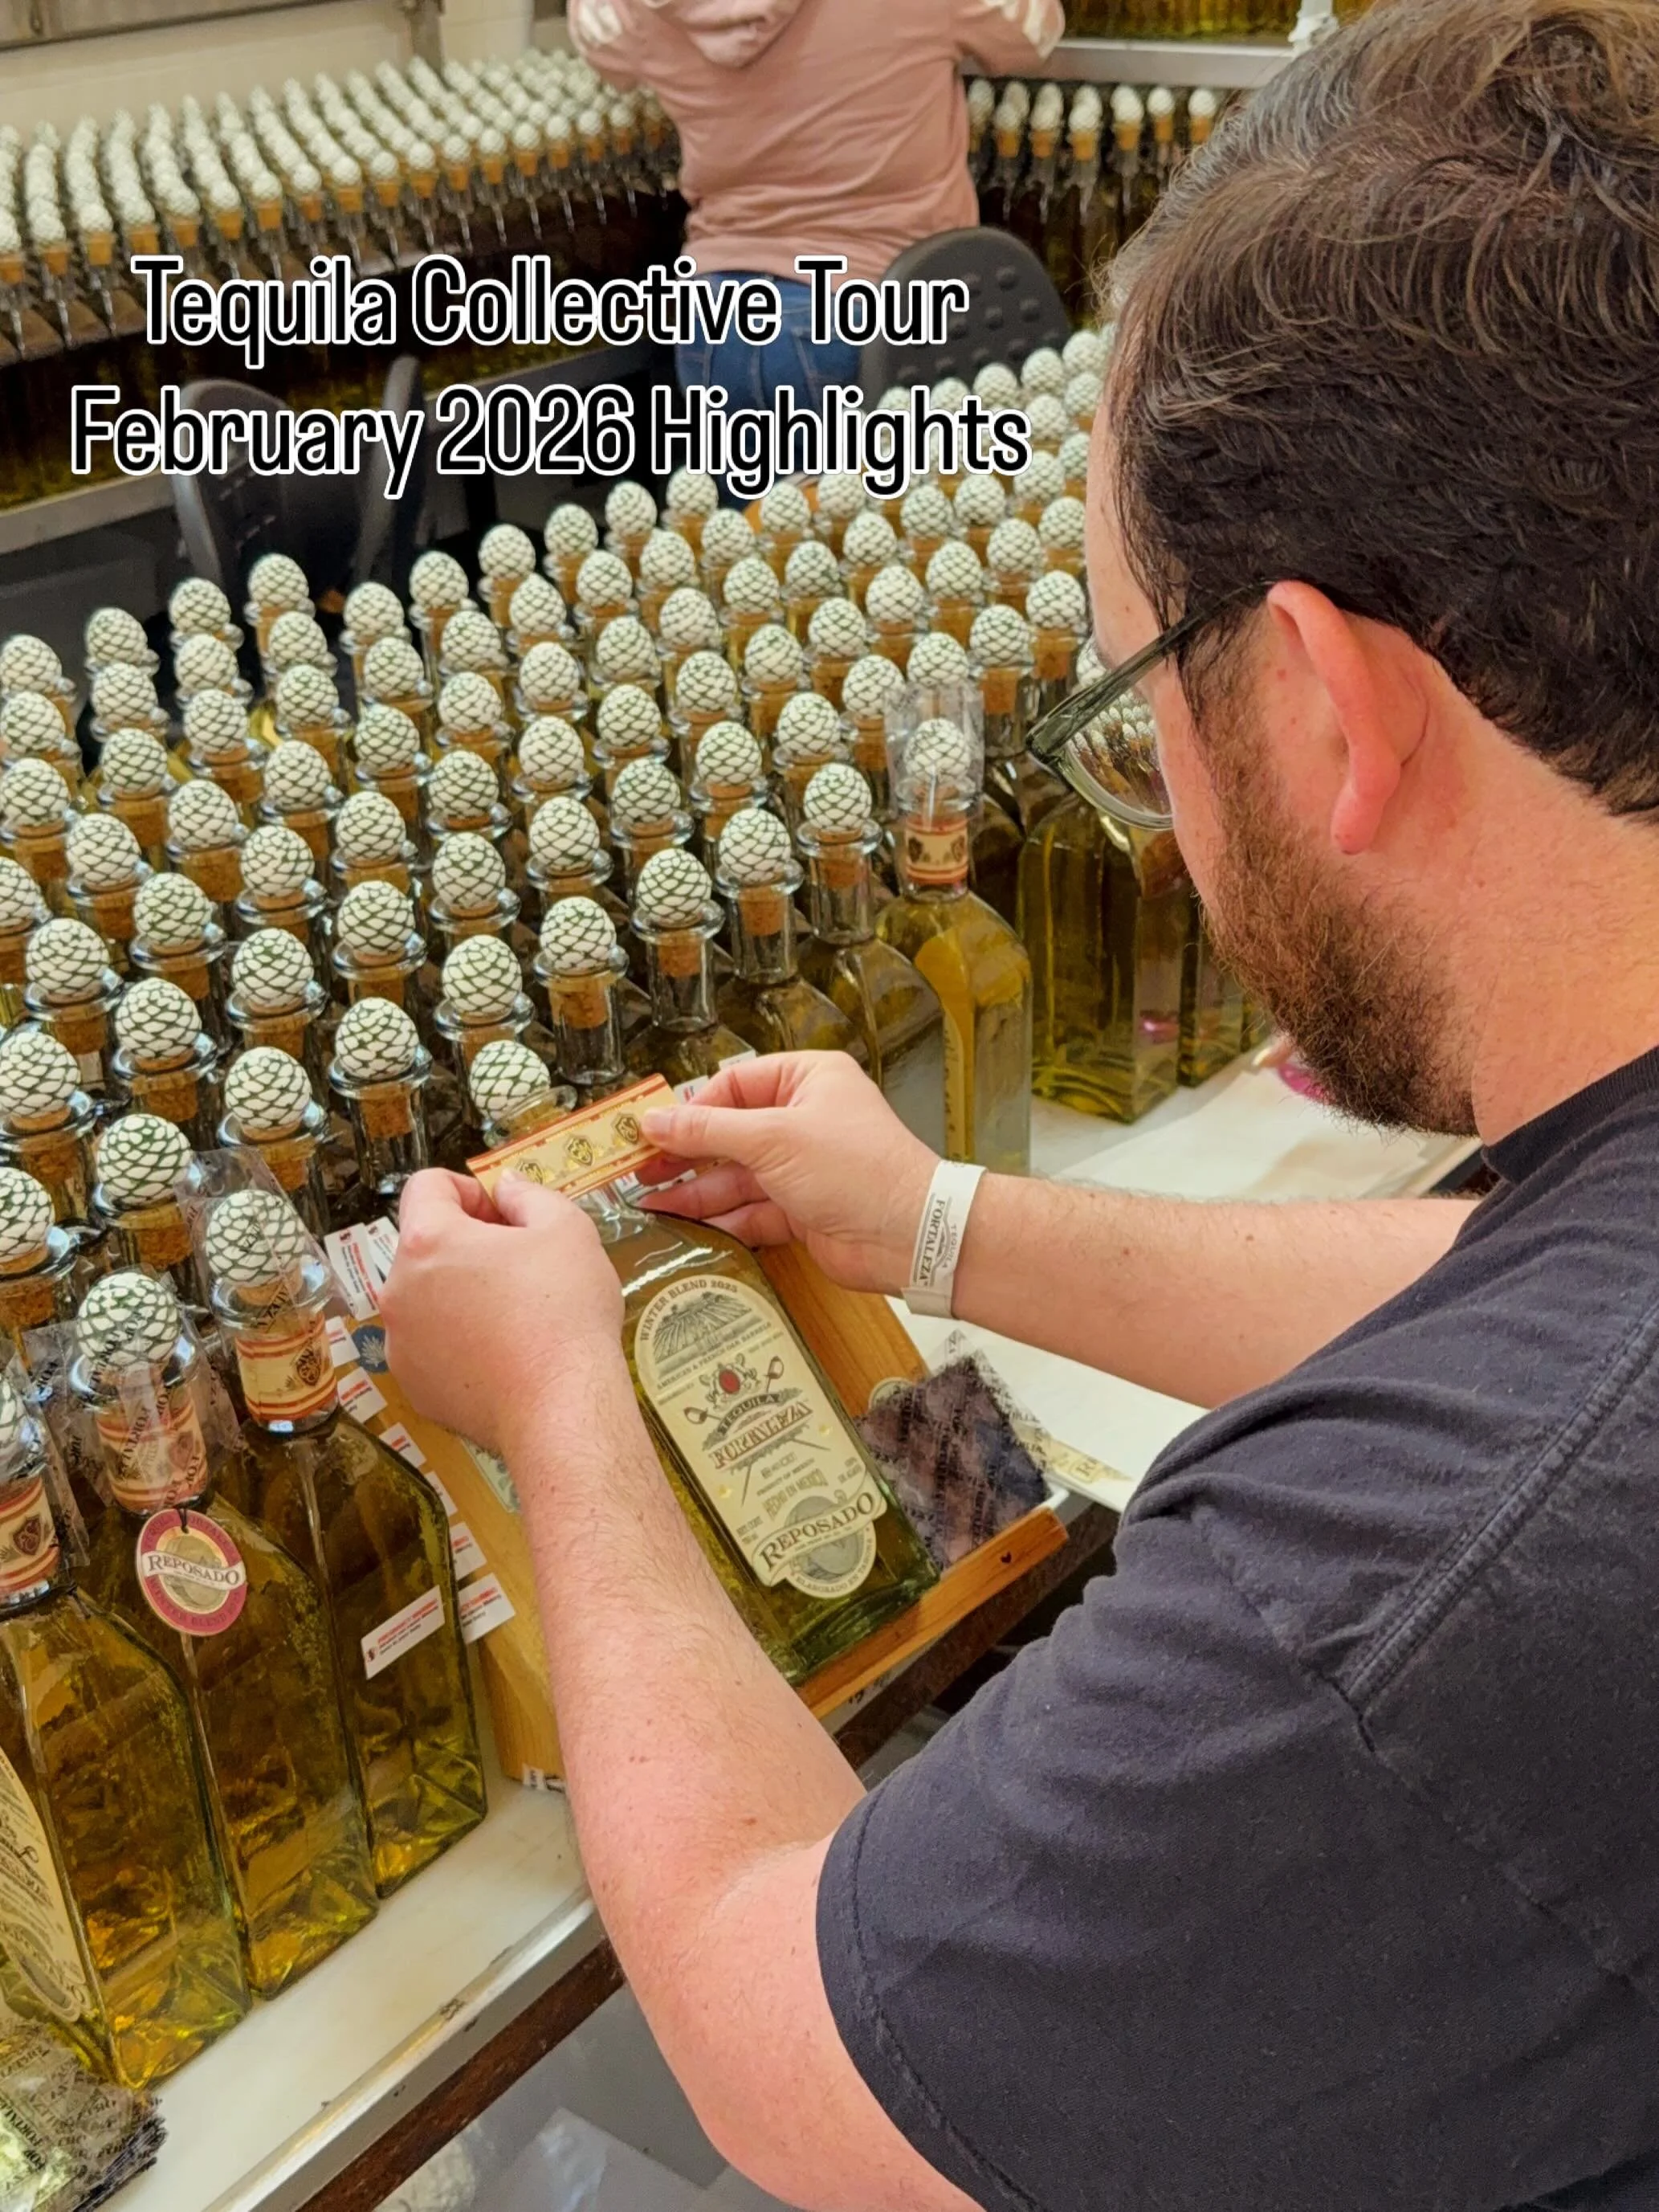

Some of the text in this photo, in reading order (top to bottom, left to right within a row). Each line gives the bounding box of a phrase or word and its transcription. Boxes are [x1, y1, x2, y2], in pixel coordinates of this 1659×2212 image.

[919, 1199, 946, 1281] FORTALEZA
[942, 1223, 959, 1269] TEQUILA
[640, 1295, 669, 1341] WINTER
[667, 1279, 707, 1300] BLEND
[709, 1402, 813, 1470] FORTALEZA
[720, 1395, 775, 1431] TEQUILA
[759, 1492, 874, 1570] REPOSADO
[148, 1555, 239, 1586] REPOSADO
